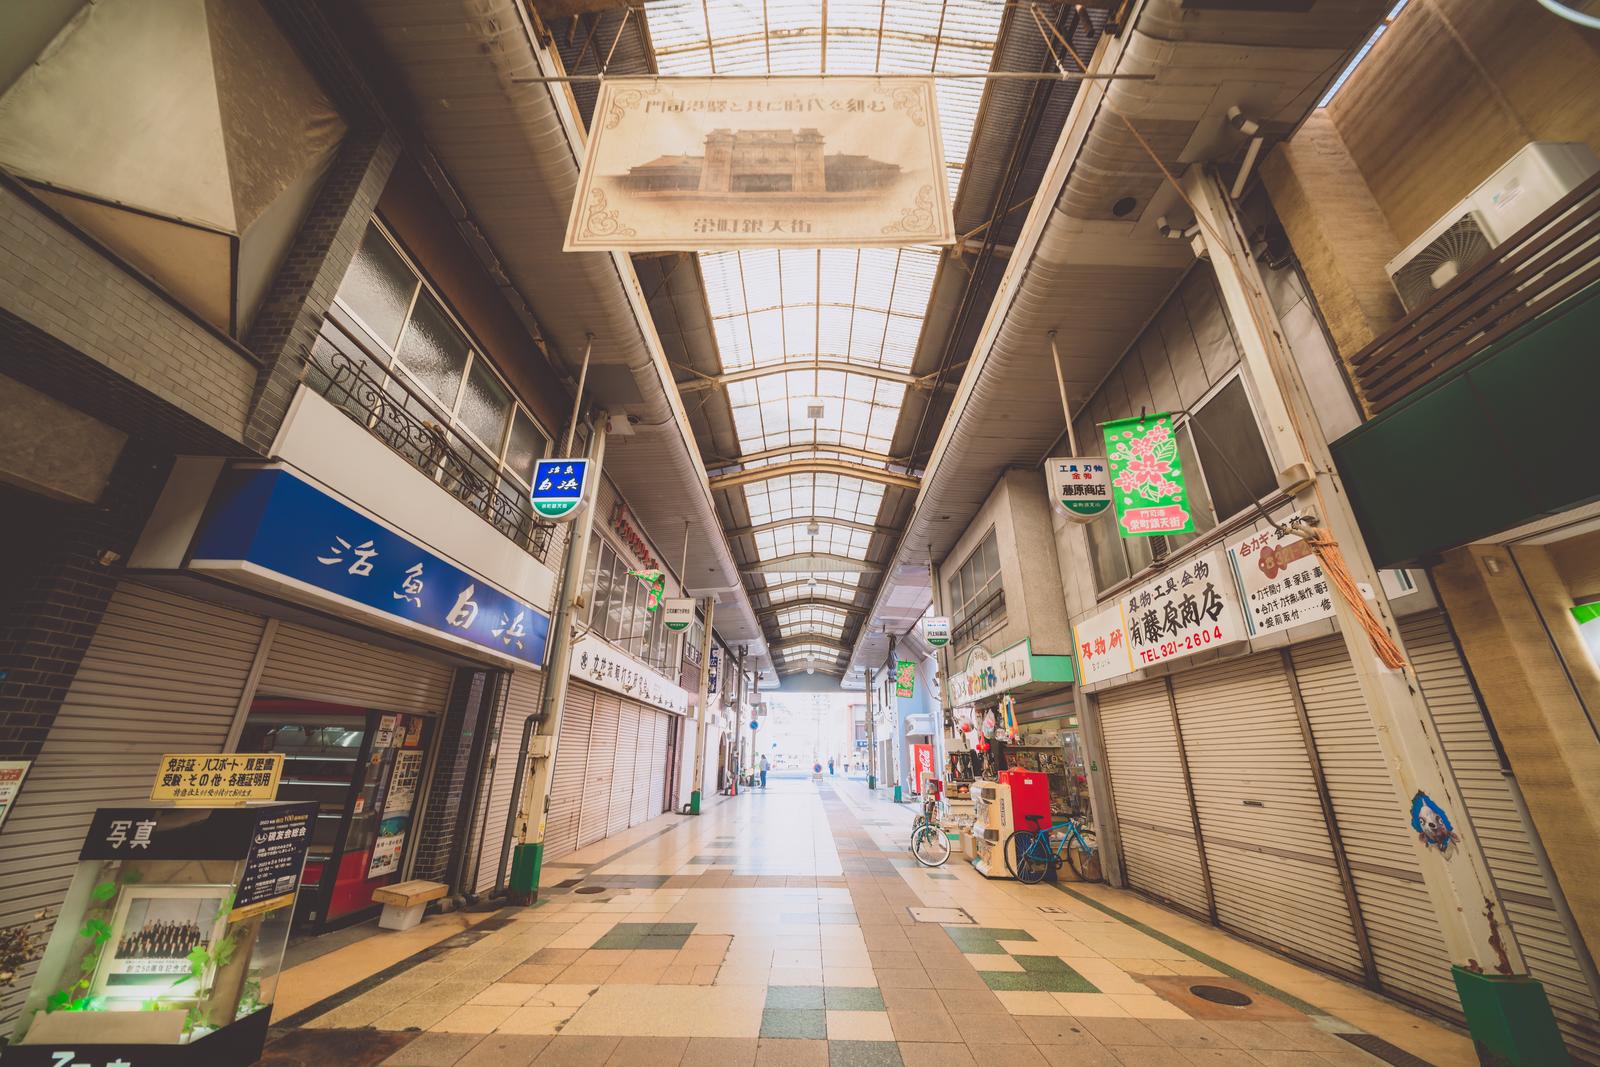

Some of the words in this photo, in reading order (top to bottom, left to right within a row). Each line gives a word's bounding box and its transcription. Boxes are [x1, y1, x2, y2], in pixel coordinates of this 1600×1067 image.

[538, 478, 579, 491] 白浜
[1062, 484, 1106, 496] 藤原商店
[1140, 648, 1160, 664] TEL
[1160, 625, 1223, 657] 321-2604
[106, 819, 157, 849] 写真
